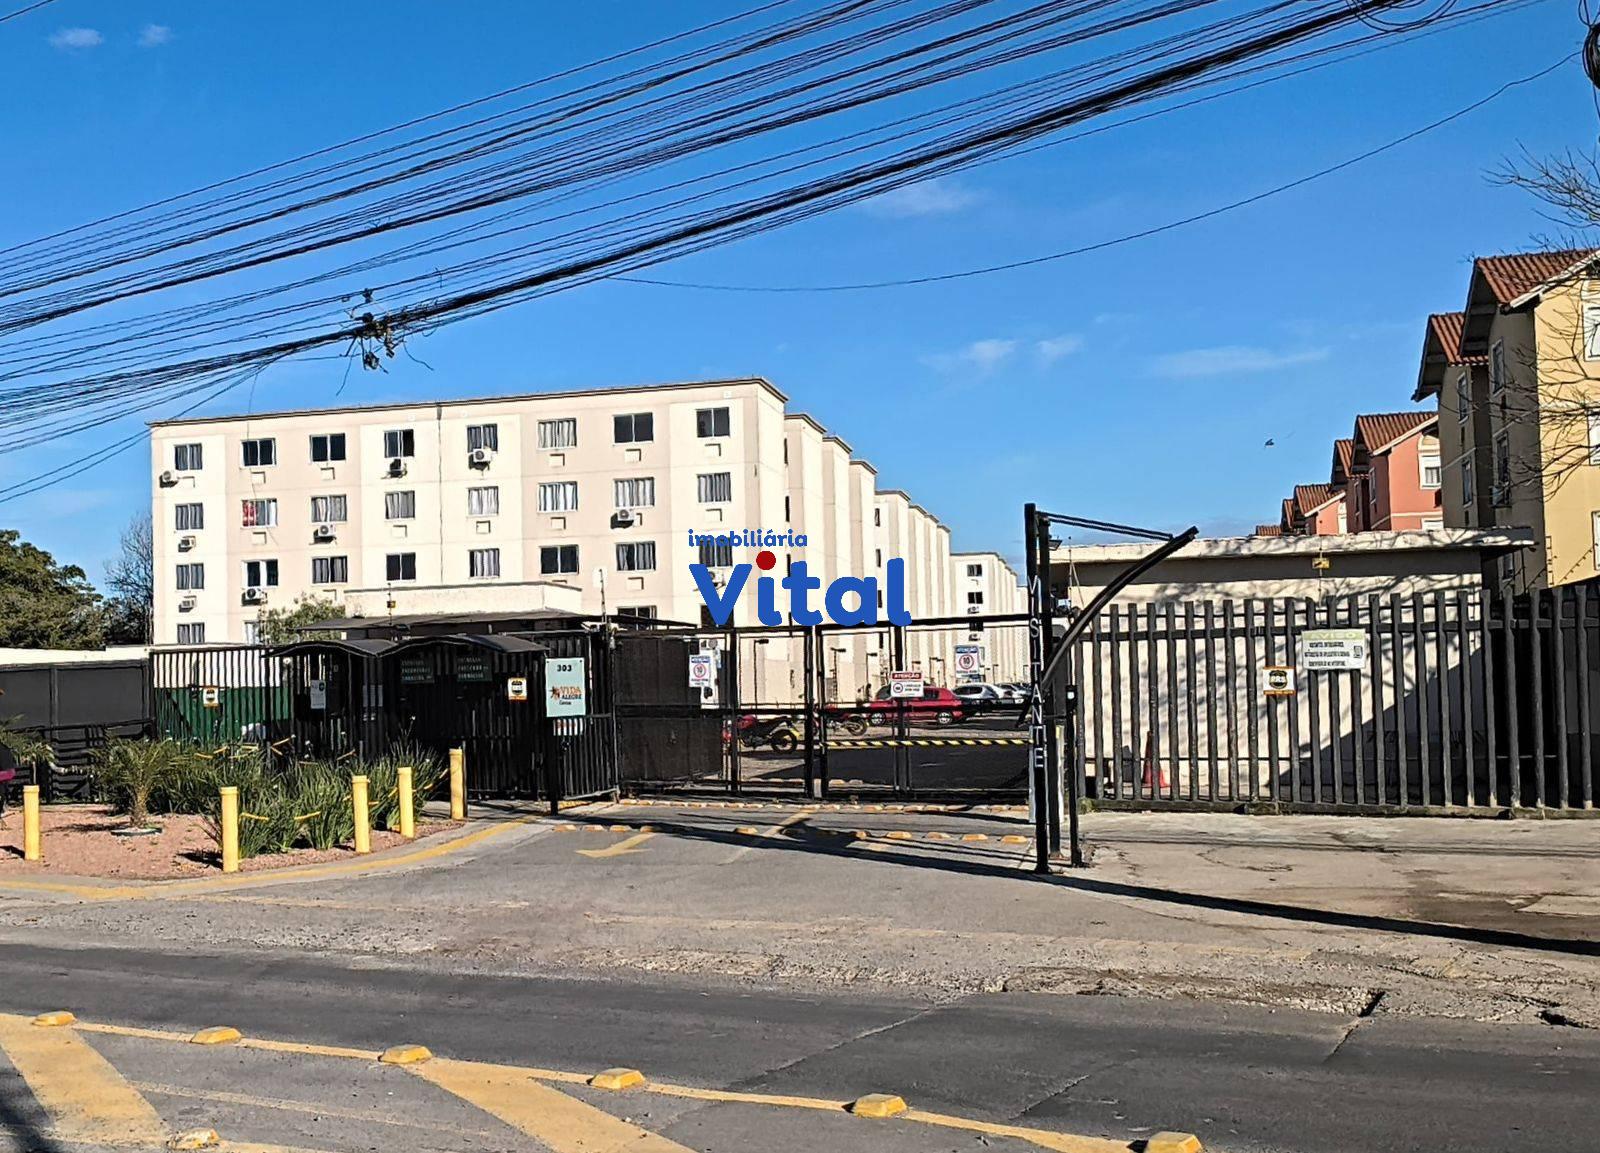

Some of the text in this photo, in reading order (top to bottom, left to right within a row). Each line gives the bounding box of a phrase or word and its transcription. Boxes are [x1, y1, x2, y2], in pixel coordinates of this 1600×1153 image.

[1310, 631, 1357, 640] AVISO
[556, 664, 572, 672] 303
[1028, 575, 1045, 768] VISITANTE
[560, 686, 582, 695] VIDA
